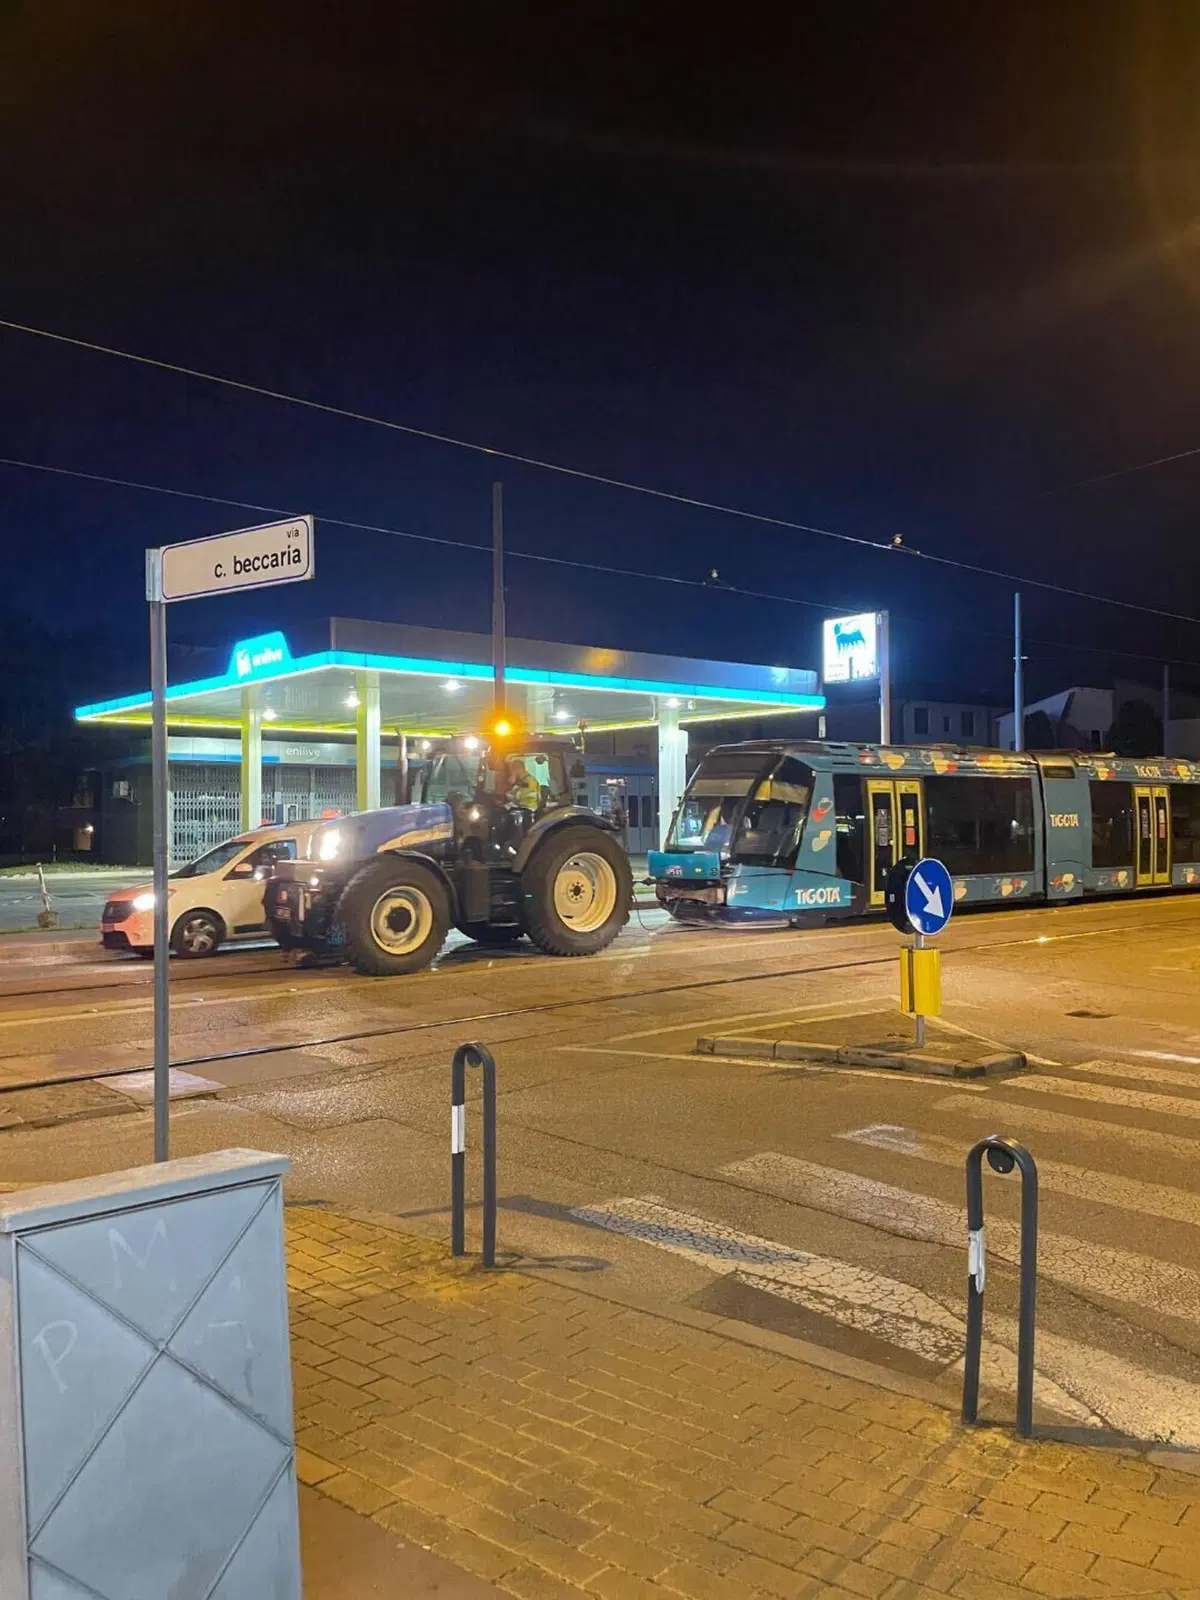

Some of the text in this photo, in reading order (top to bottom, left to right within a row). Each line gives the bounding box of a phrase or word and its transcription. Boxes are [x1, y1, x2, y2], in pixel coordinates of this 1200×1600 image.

[286, 528, 300, 539] via
[214, 544, 302, 578] c. beccaria
[286, 746, 321, 757] enilive
